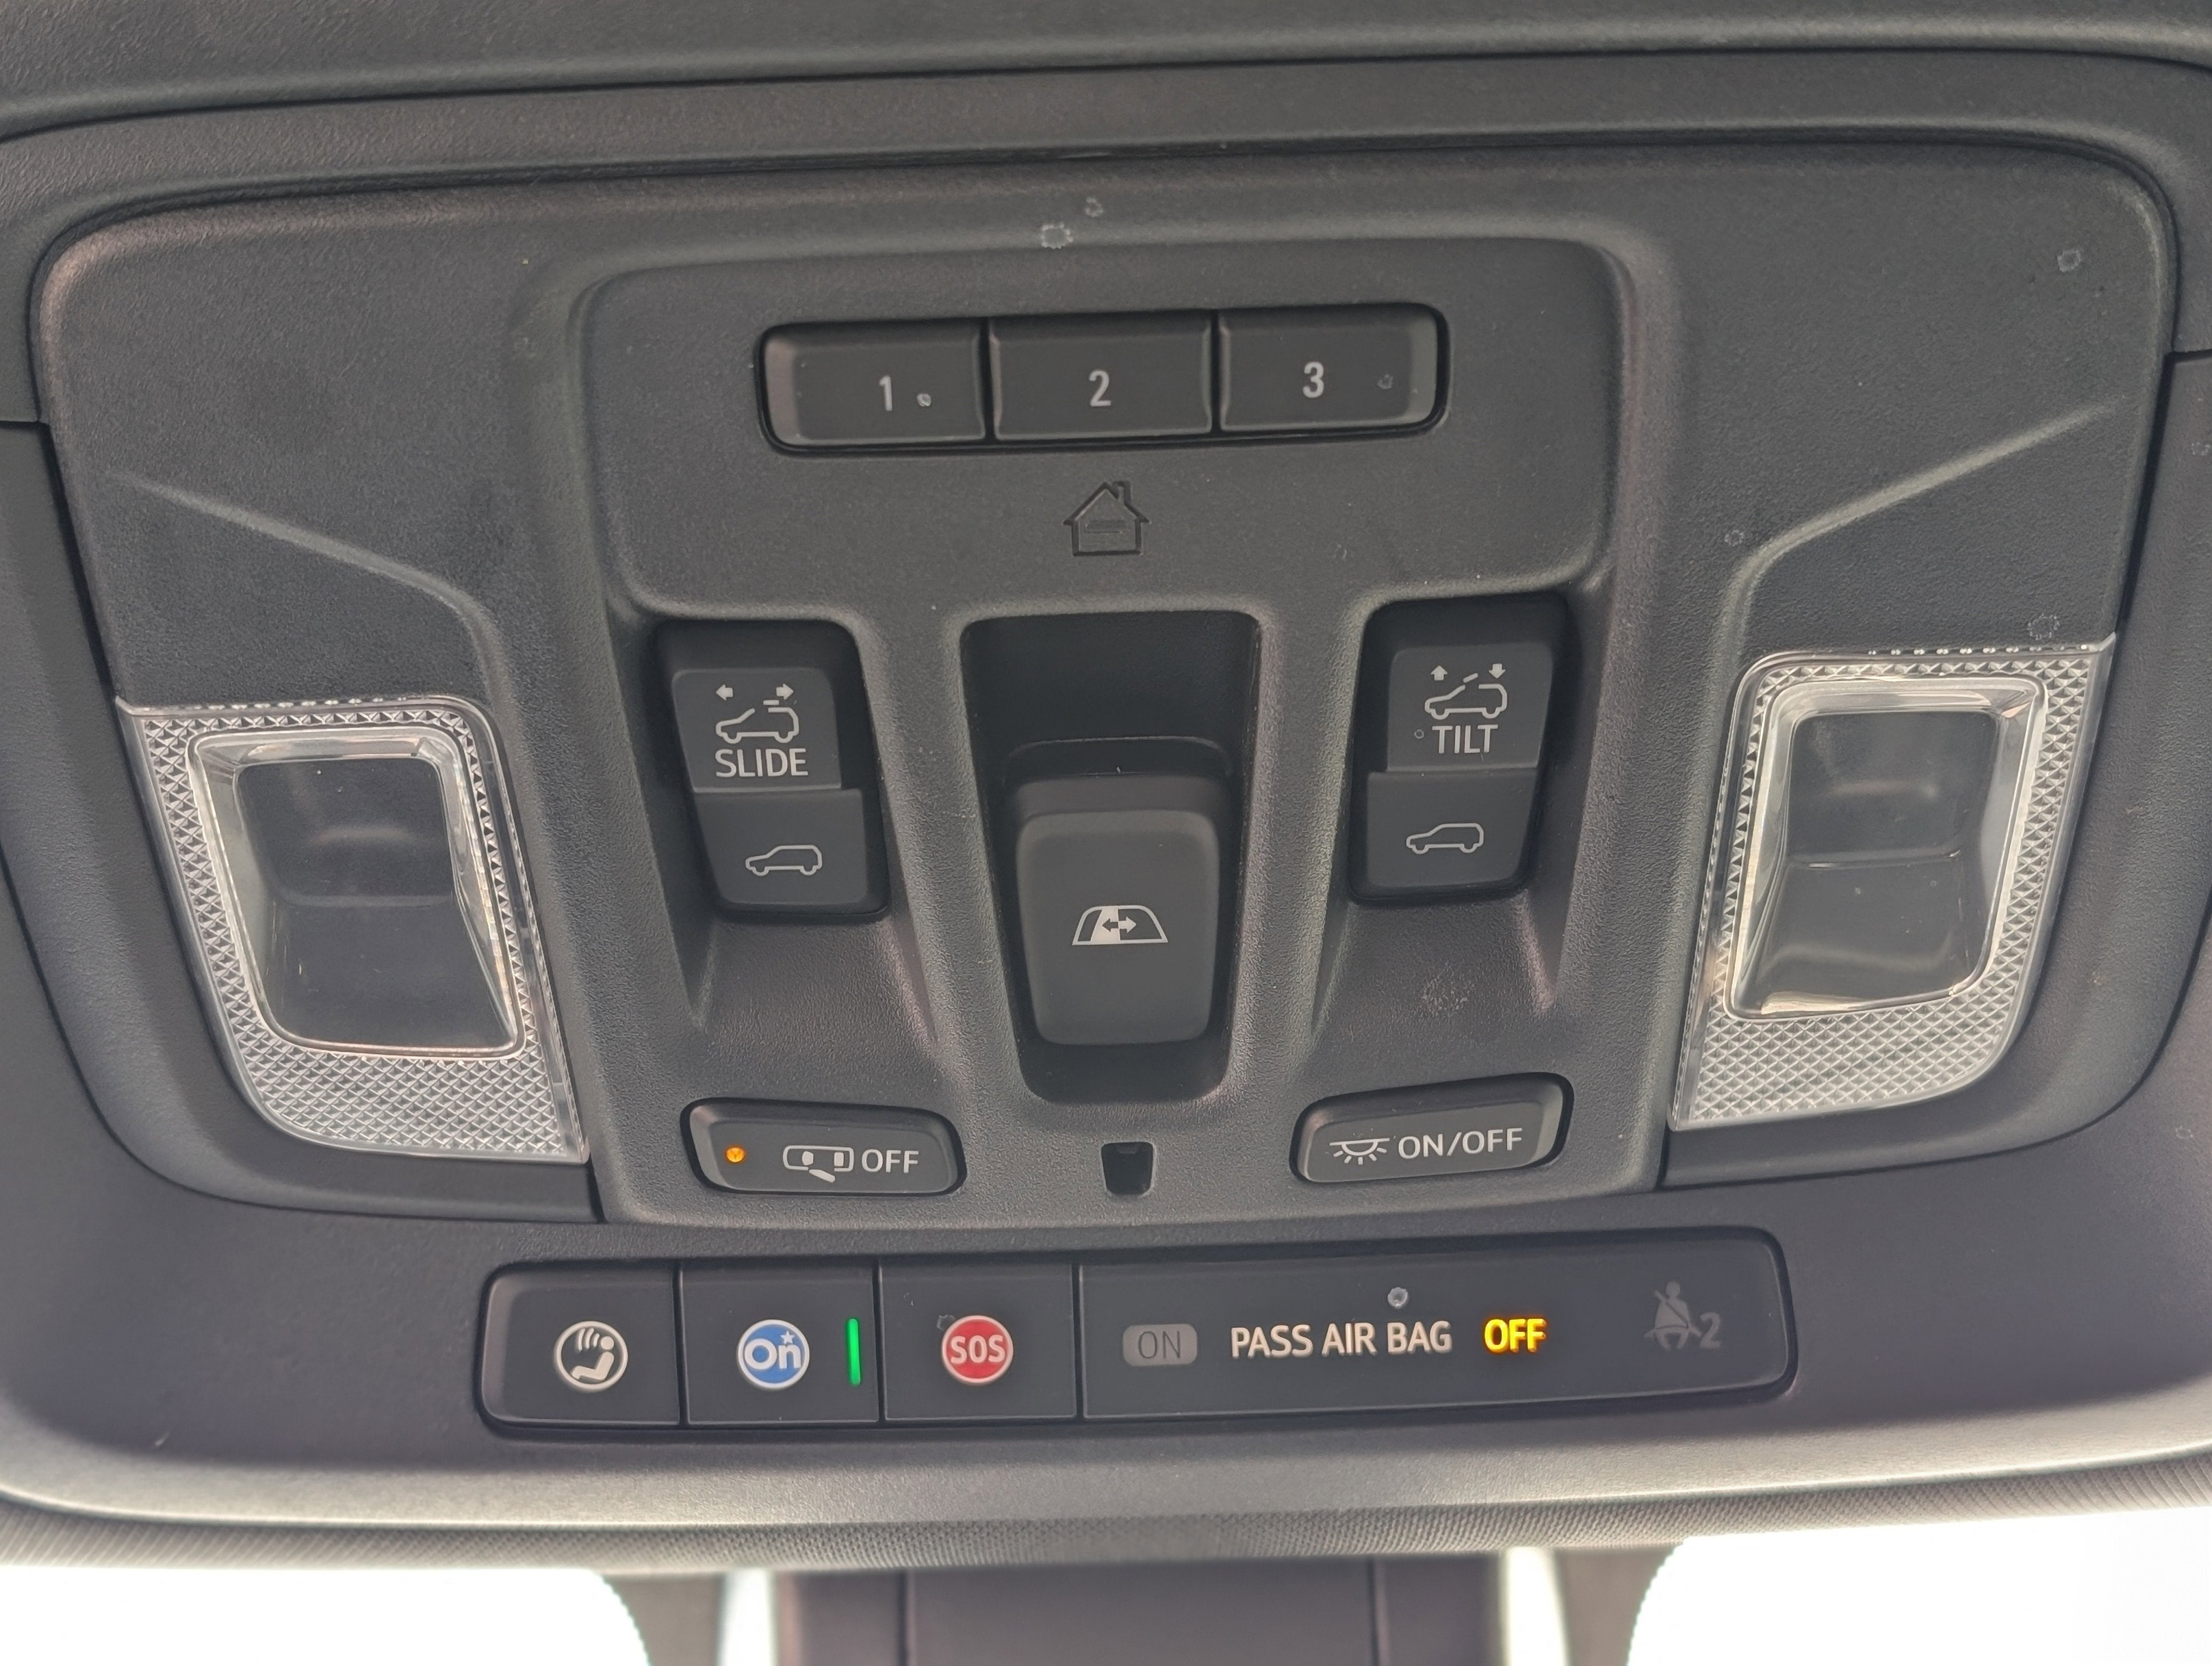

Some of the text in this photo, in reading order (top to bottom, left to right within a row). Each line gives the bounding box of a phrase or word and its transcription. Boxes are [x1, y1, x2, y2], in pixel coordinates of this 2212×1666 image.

[879, 375, 893, 412] 1
[1089, 369, 1112, 407] 2
[1302, 361, 1324, 399] 3
[1431, 724, 1499, 753] TILT
[715, 748, 808, 777] SLIDE
[1398, 1127, 1522, 1159] ON/OFF
[861, 1148, 919, 1174] OFF
[1137, 1329, 1182, 1361] ON
[1230, 1317, 1548, 1358] PASS AIR BAG OFF
[1698, 1311, 1723, 1351] 2
[743, 1338, 802, 1371] On
[950, 1334, 1006, 1366] SOS
